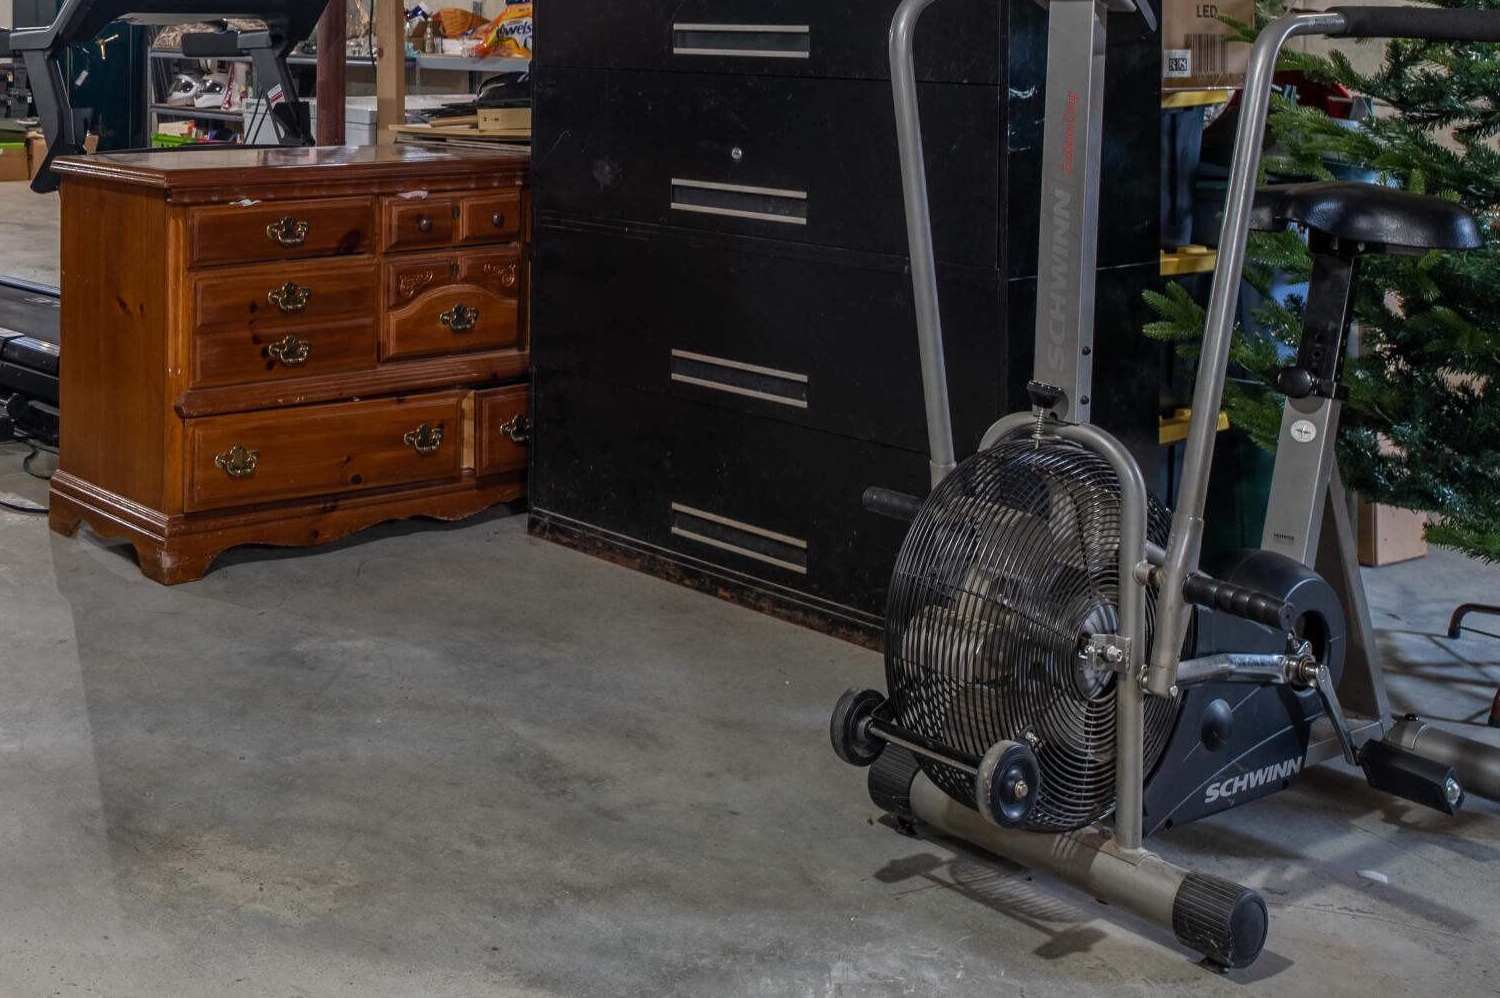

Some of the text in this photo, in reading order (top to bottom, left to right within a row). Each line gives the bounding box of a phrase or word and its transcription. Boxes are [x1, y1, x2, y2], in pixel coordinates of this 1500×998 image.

[1196, 5, 1218, 19] LED
[1049, 188, 1072, 372] SCHWINN
[1204, 755, 1303, 803] SCHWINN
